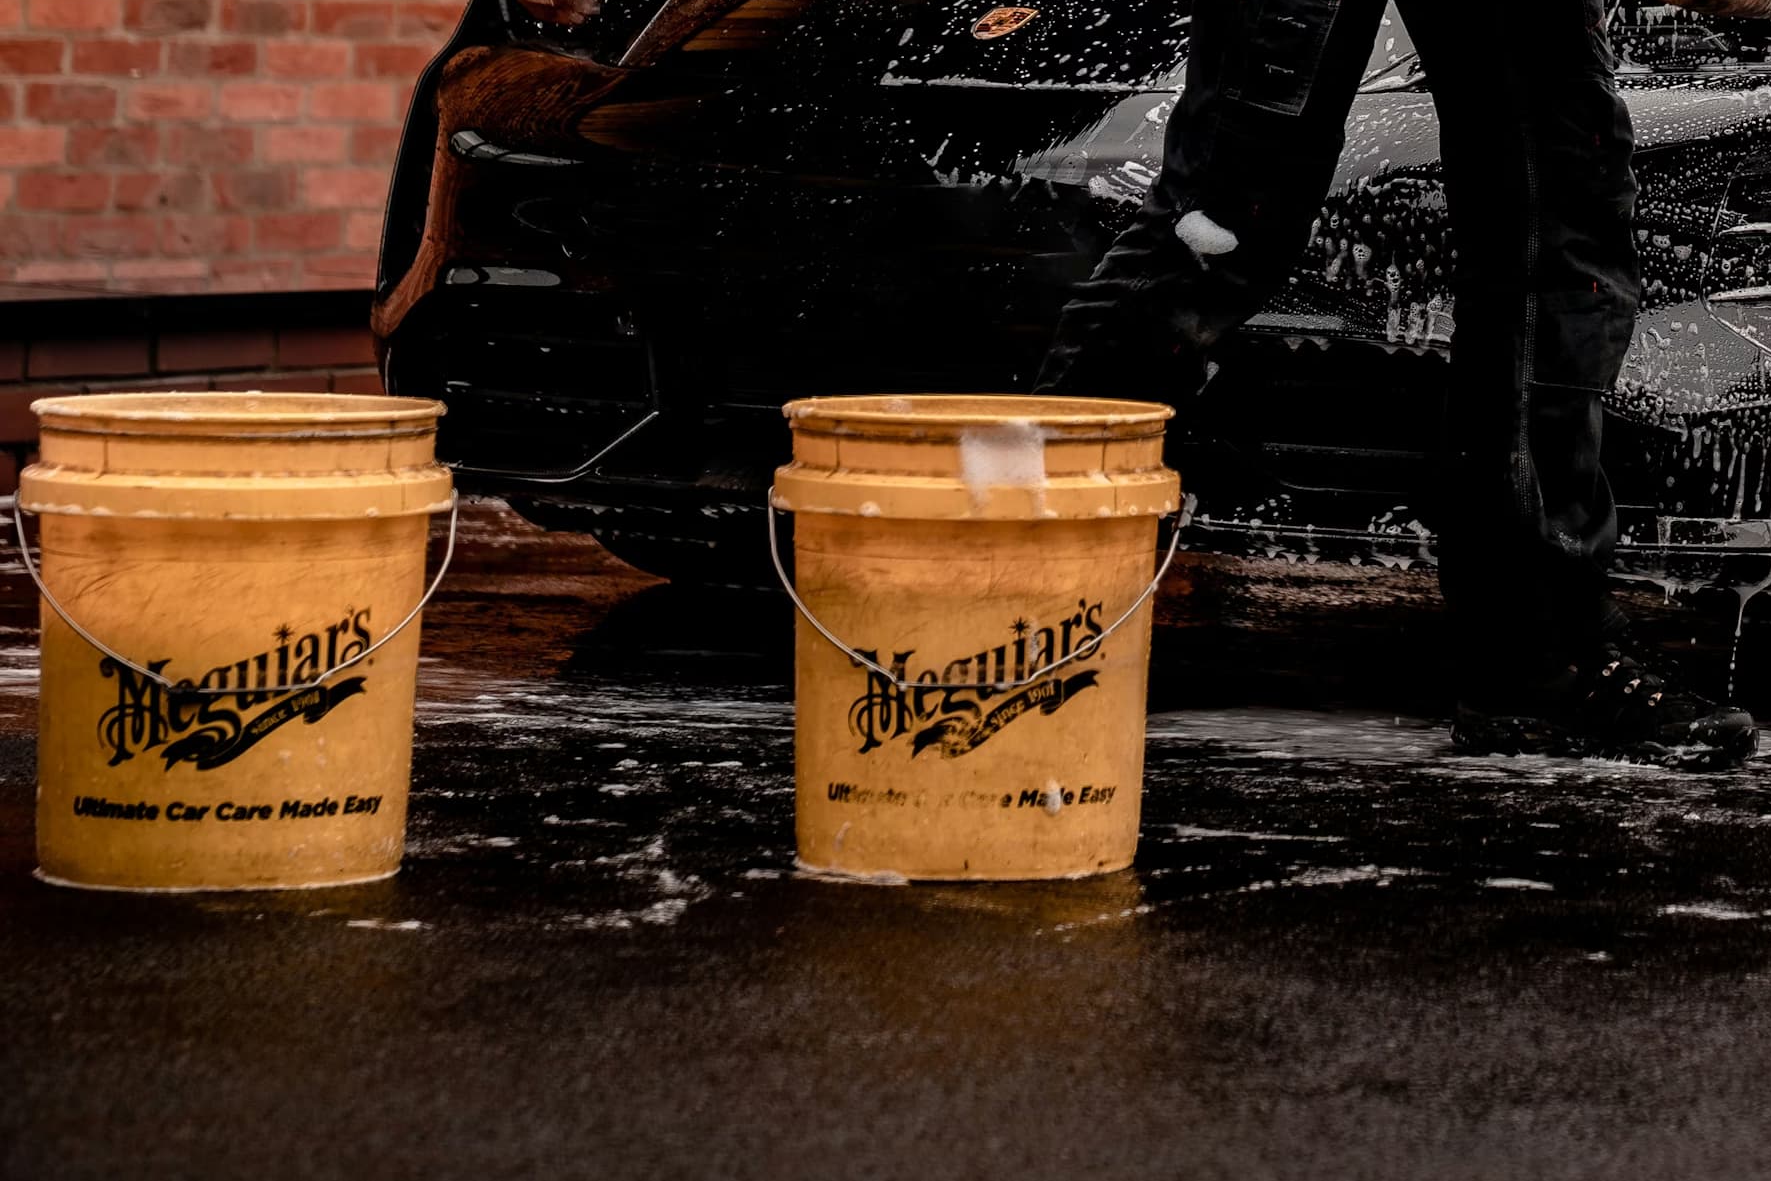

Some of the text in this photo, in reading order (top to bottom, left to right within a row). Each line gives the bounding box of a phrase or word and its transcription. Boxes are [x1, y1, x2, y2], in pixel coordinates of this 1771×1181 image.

[97, 605, 372, 768] Meguiar's
[848, 599, 1103, 755] Meguiar's
[73, 794, 383, 822] Ultimate Car Care Made Easy
[1078, 784, 1117, 806] Easy
